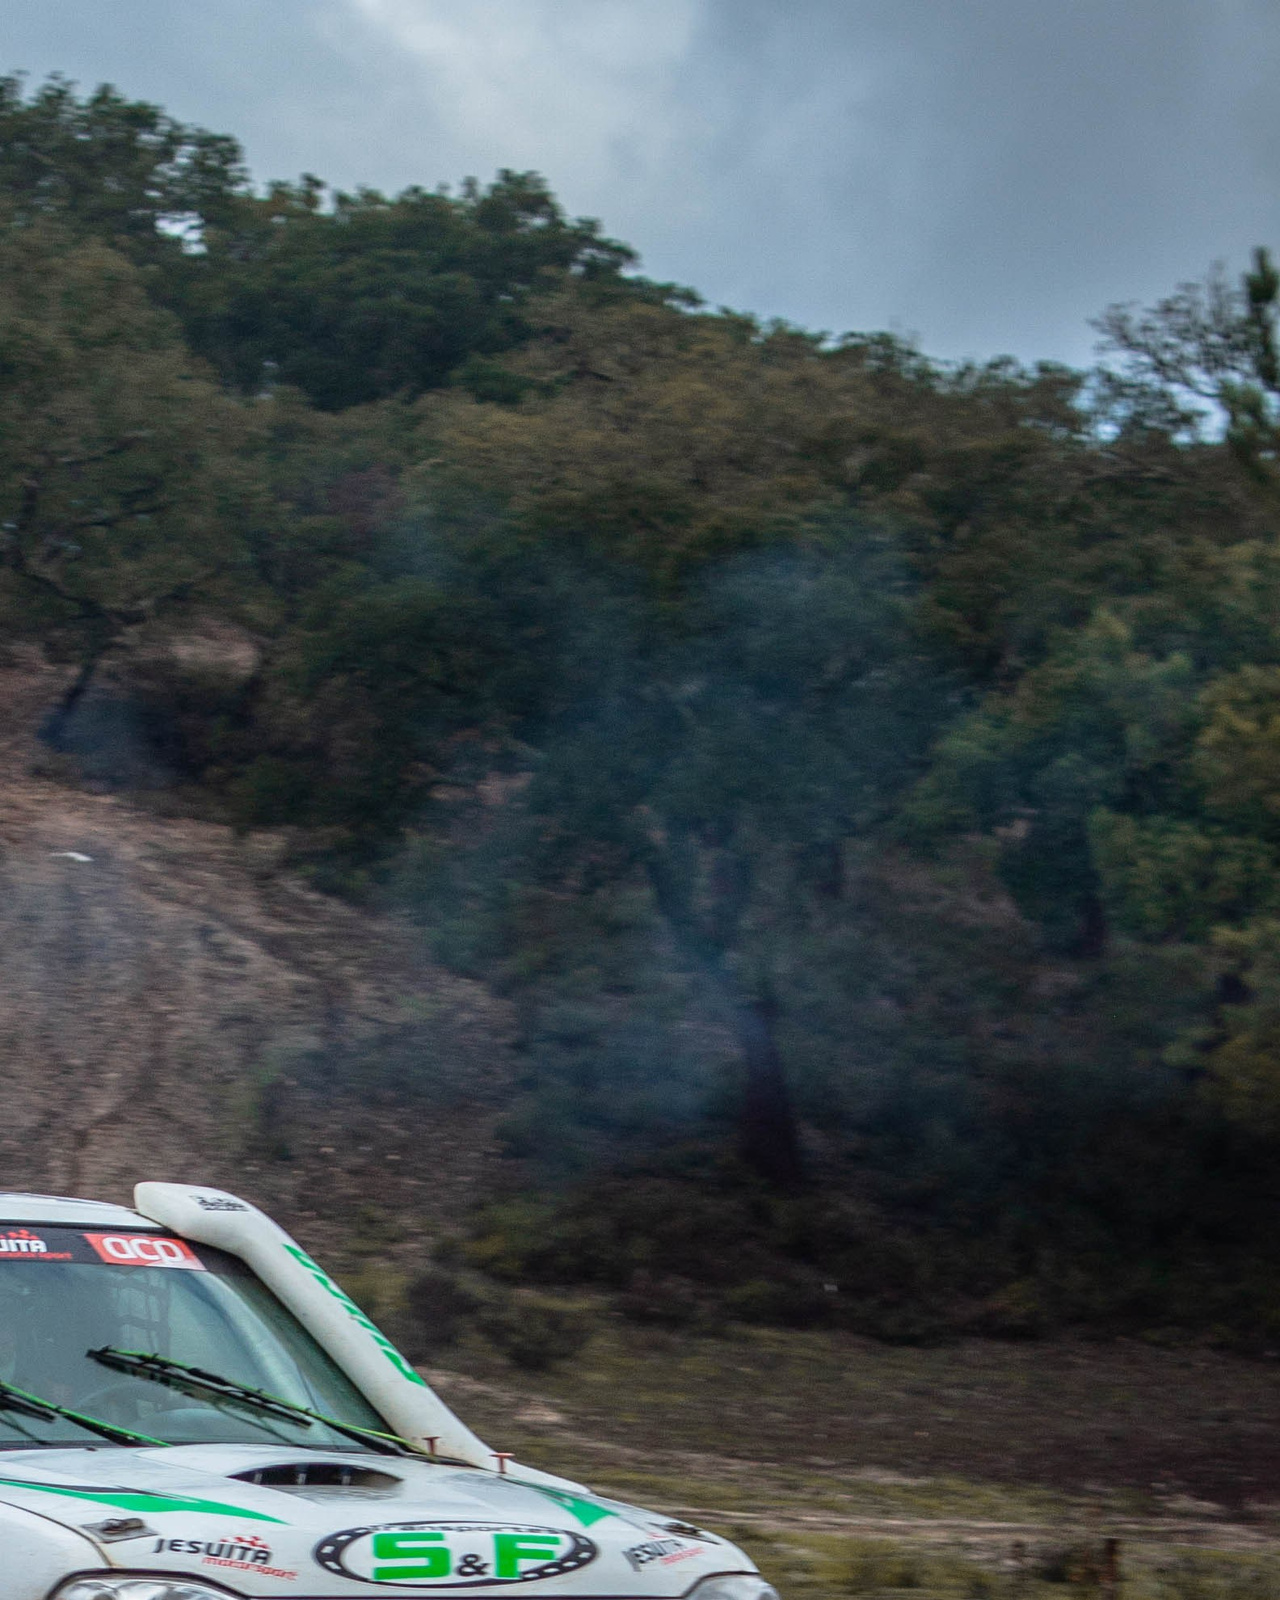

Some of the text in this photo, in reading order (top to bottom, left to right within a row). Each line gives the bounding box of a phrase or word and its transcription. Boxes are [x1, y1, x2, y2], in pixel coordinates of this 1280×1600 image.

[102, 1236, 185, 1263] acp
[152, 1537, 273, 1565] JESUITA
[372, 1532, 562, 1581] S&F
